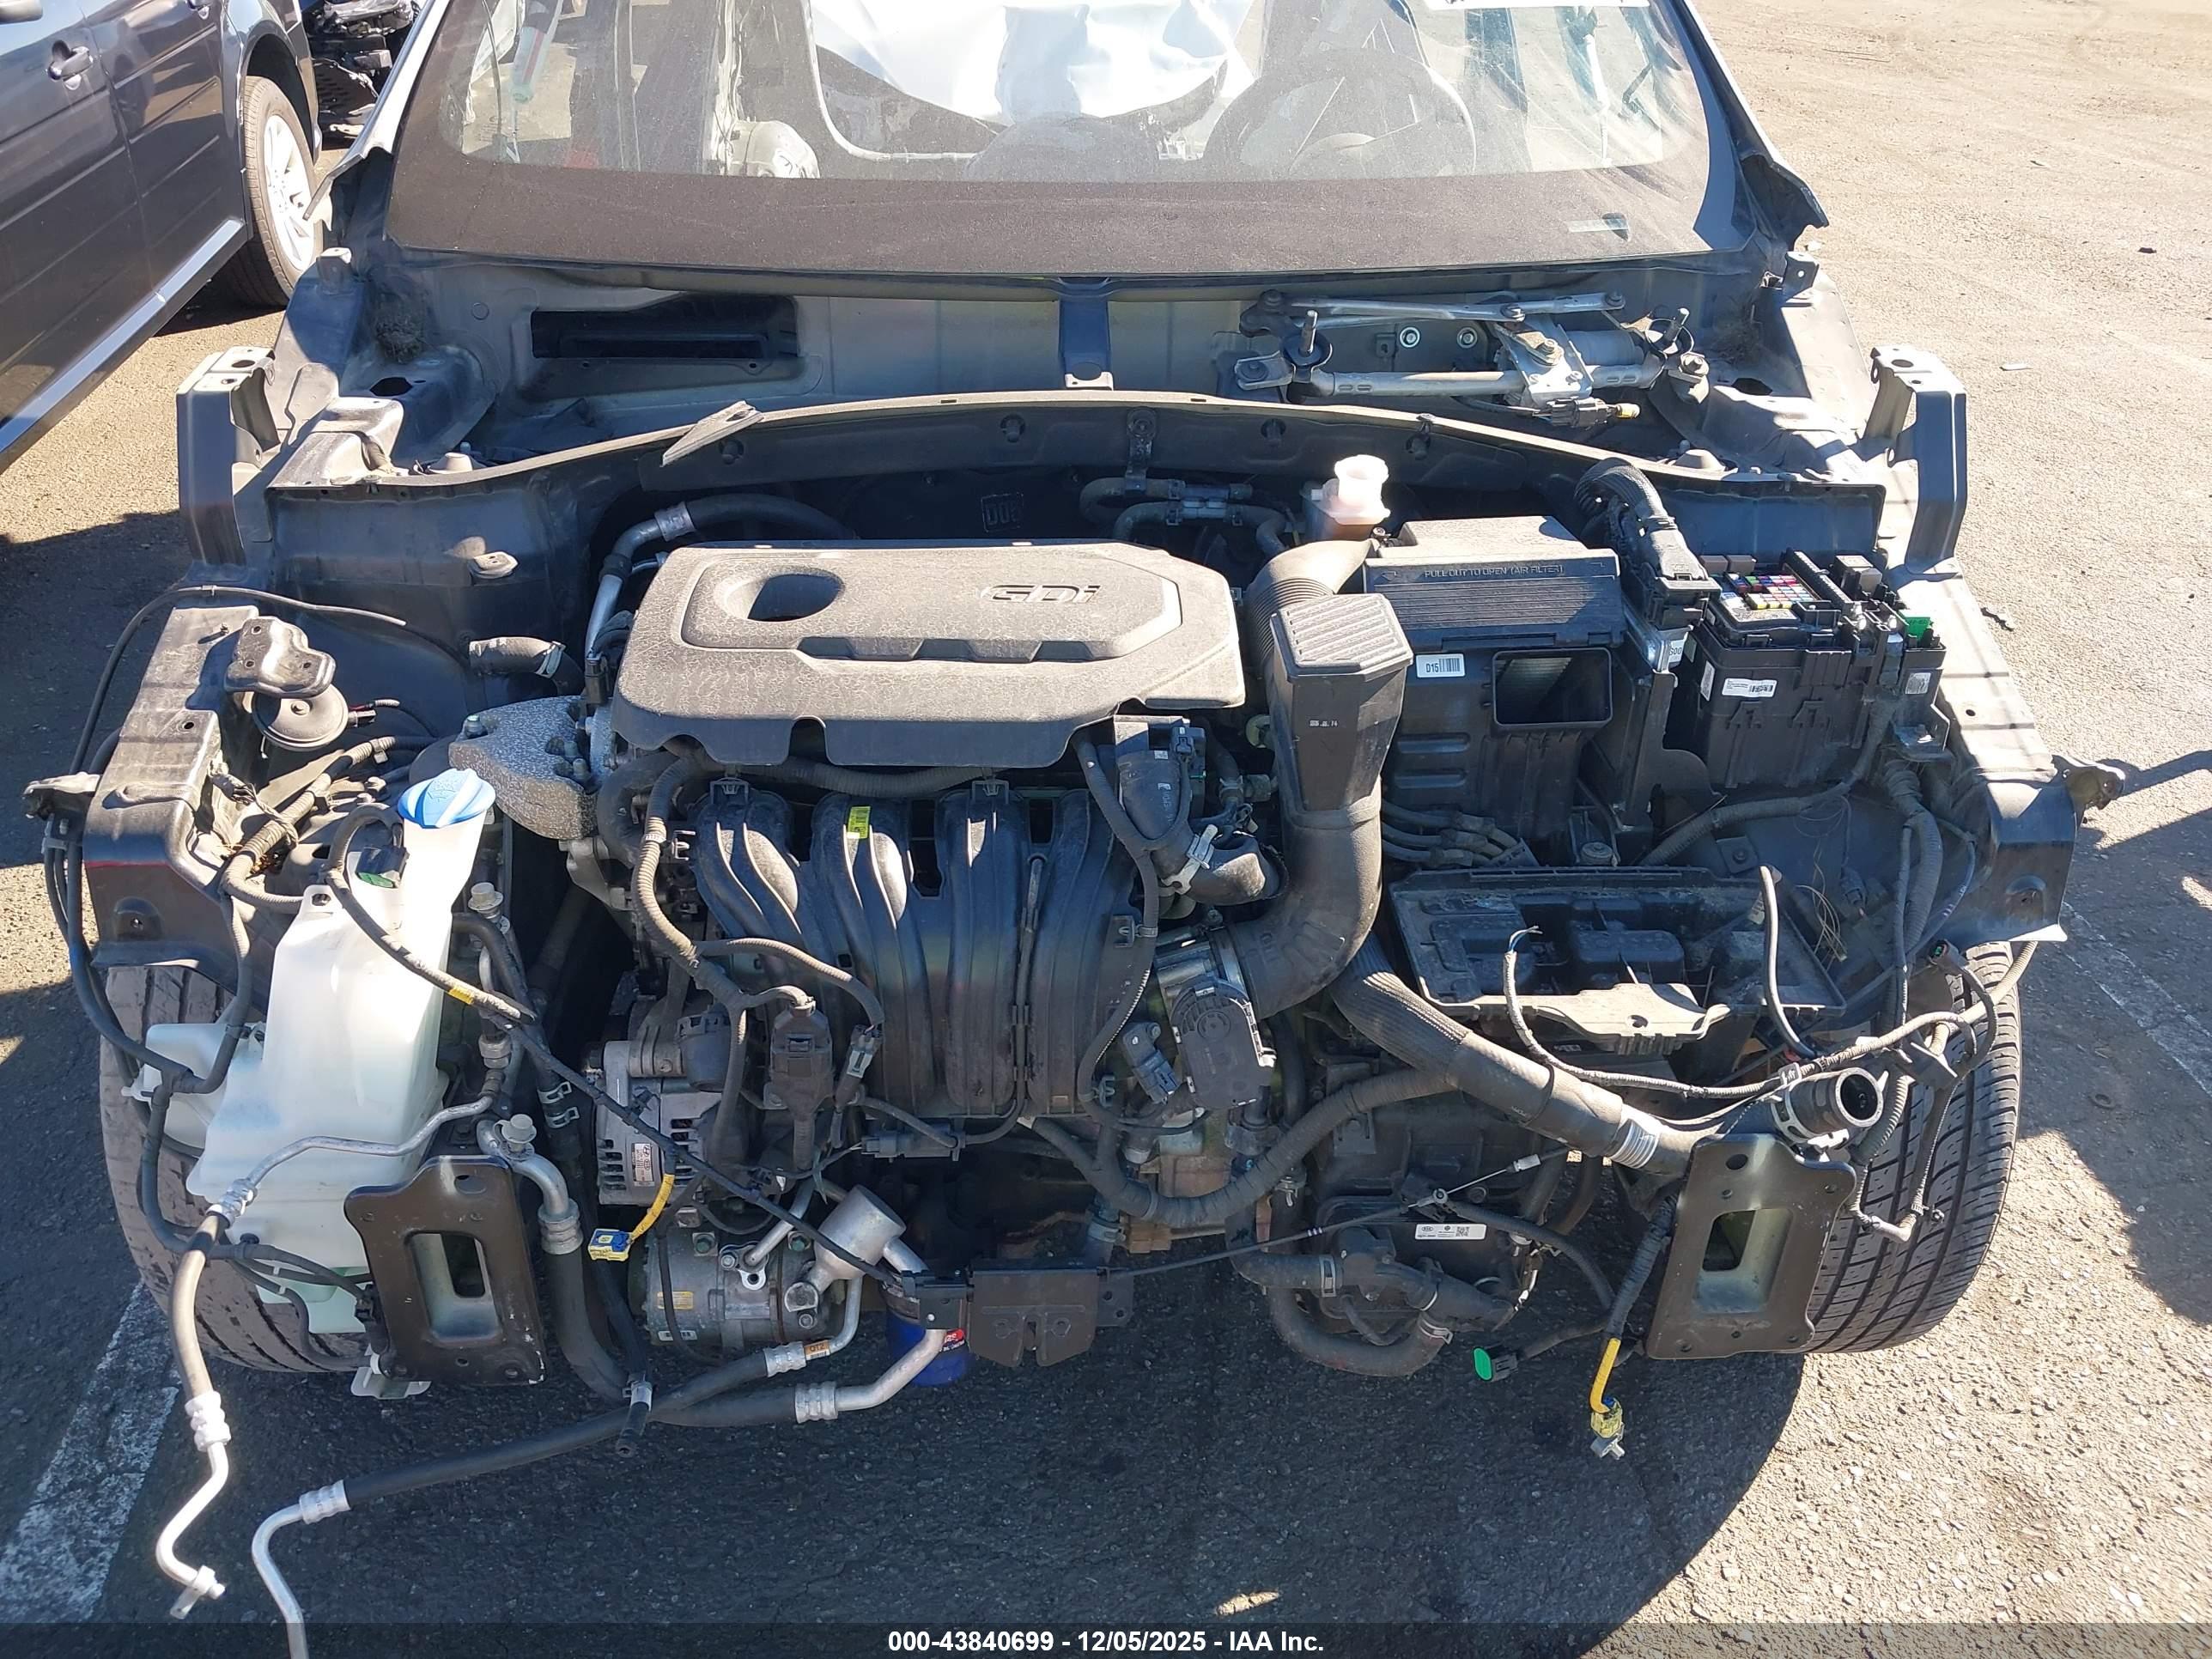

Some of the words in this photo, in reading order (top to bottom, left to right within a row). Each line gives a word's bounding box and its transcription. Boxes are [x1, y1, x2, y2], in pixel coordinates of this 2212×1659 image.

[1424, 569, 1448, 579] PULL
[1448, 568, 1467, 578] OUT
[1468, 568, 1482, 577] TO
[1483, 567, 1507, 576] OPEN
